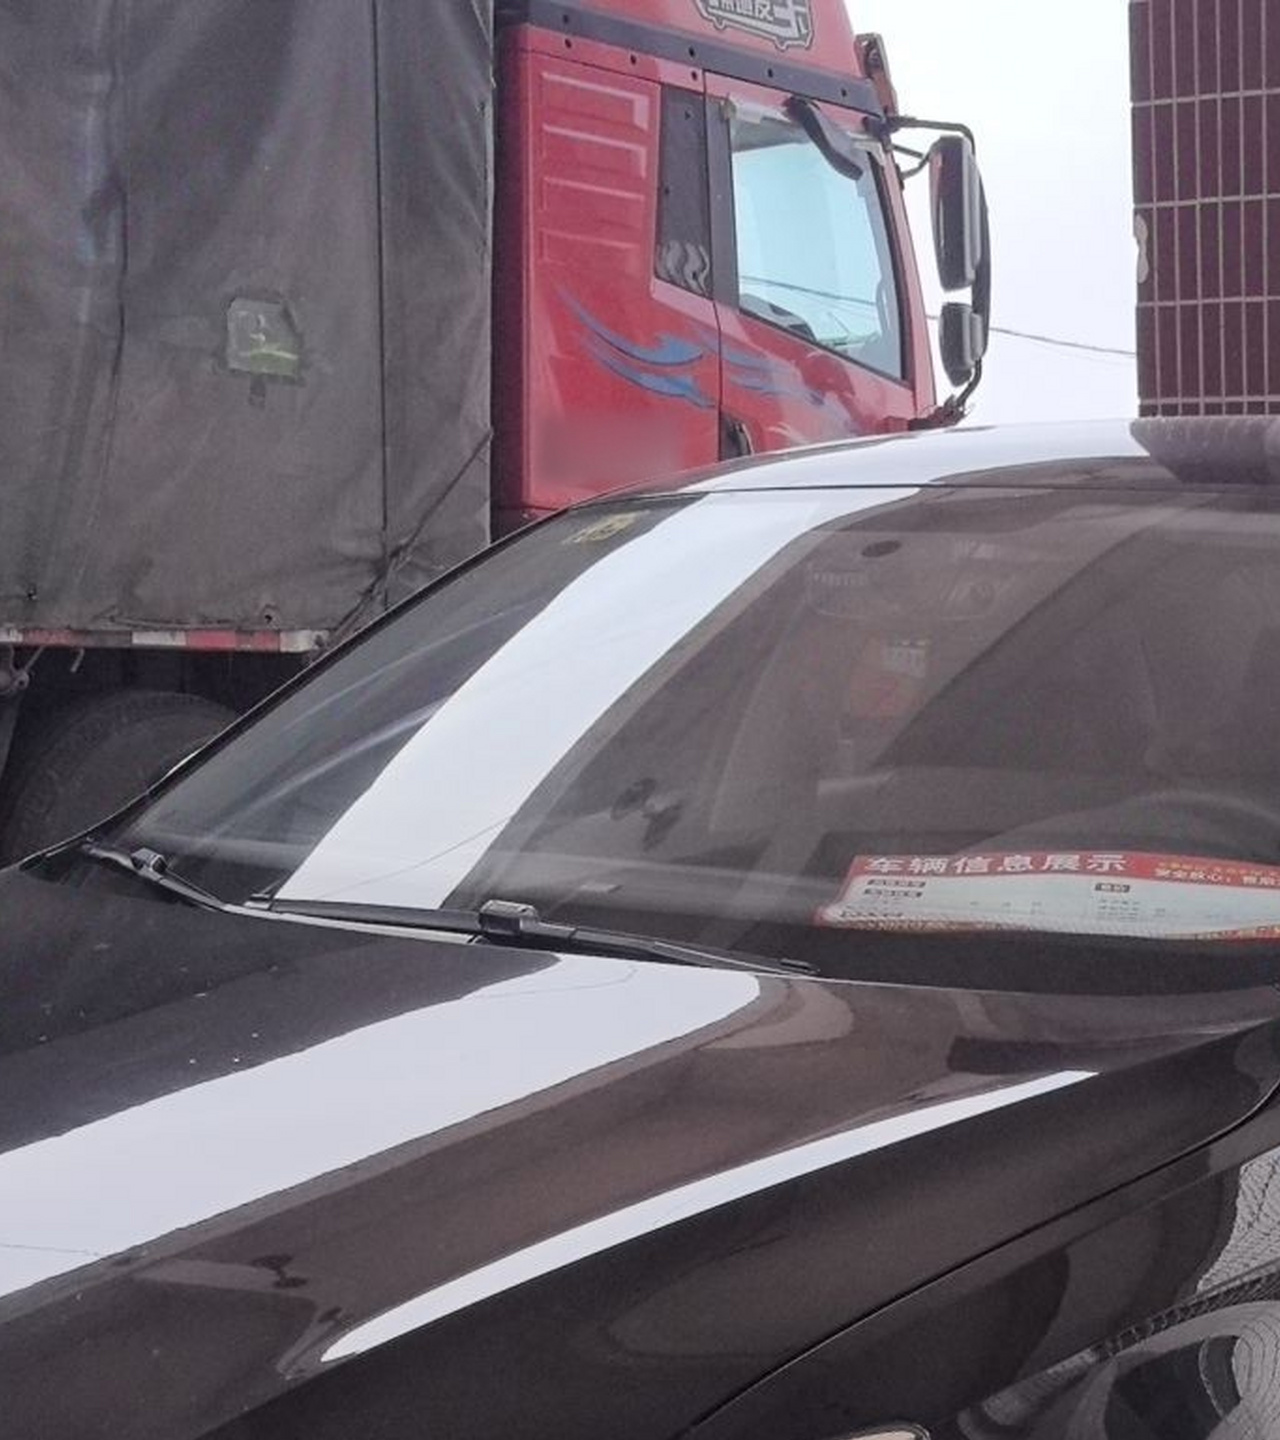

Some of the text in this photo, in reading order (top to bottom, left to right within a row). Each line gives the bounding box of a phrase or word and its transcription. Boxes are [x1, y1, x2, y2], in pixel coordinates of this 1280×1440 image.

[867, 855, 1126, 873] 车辆信息展示
